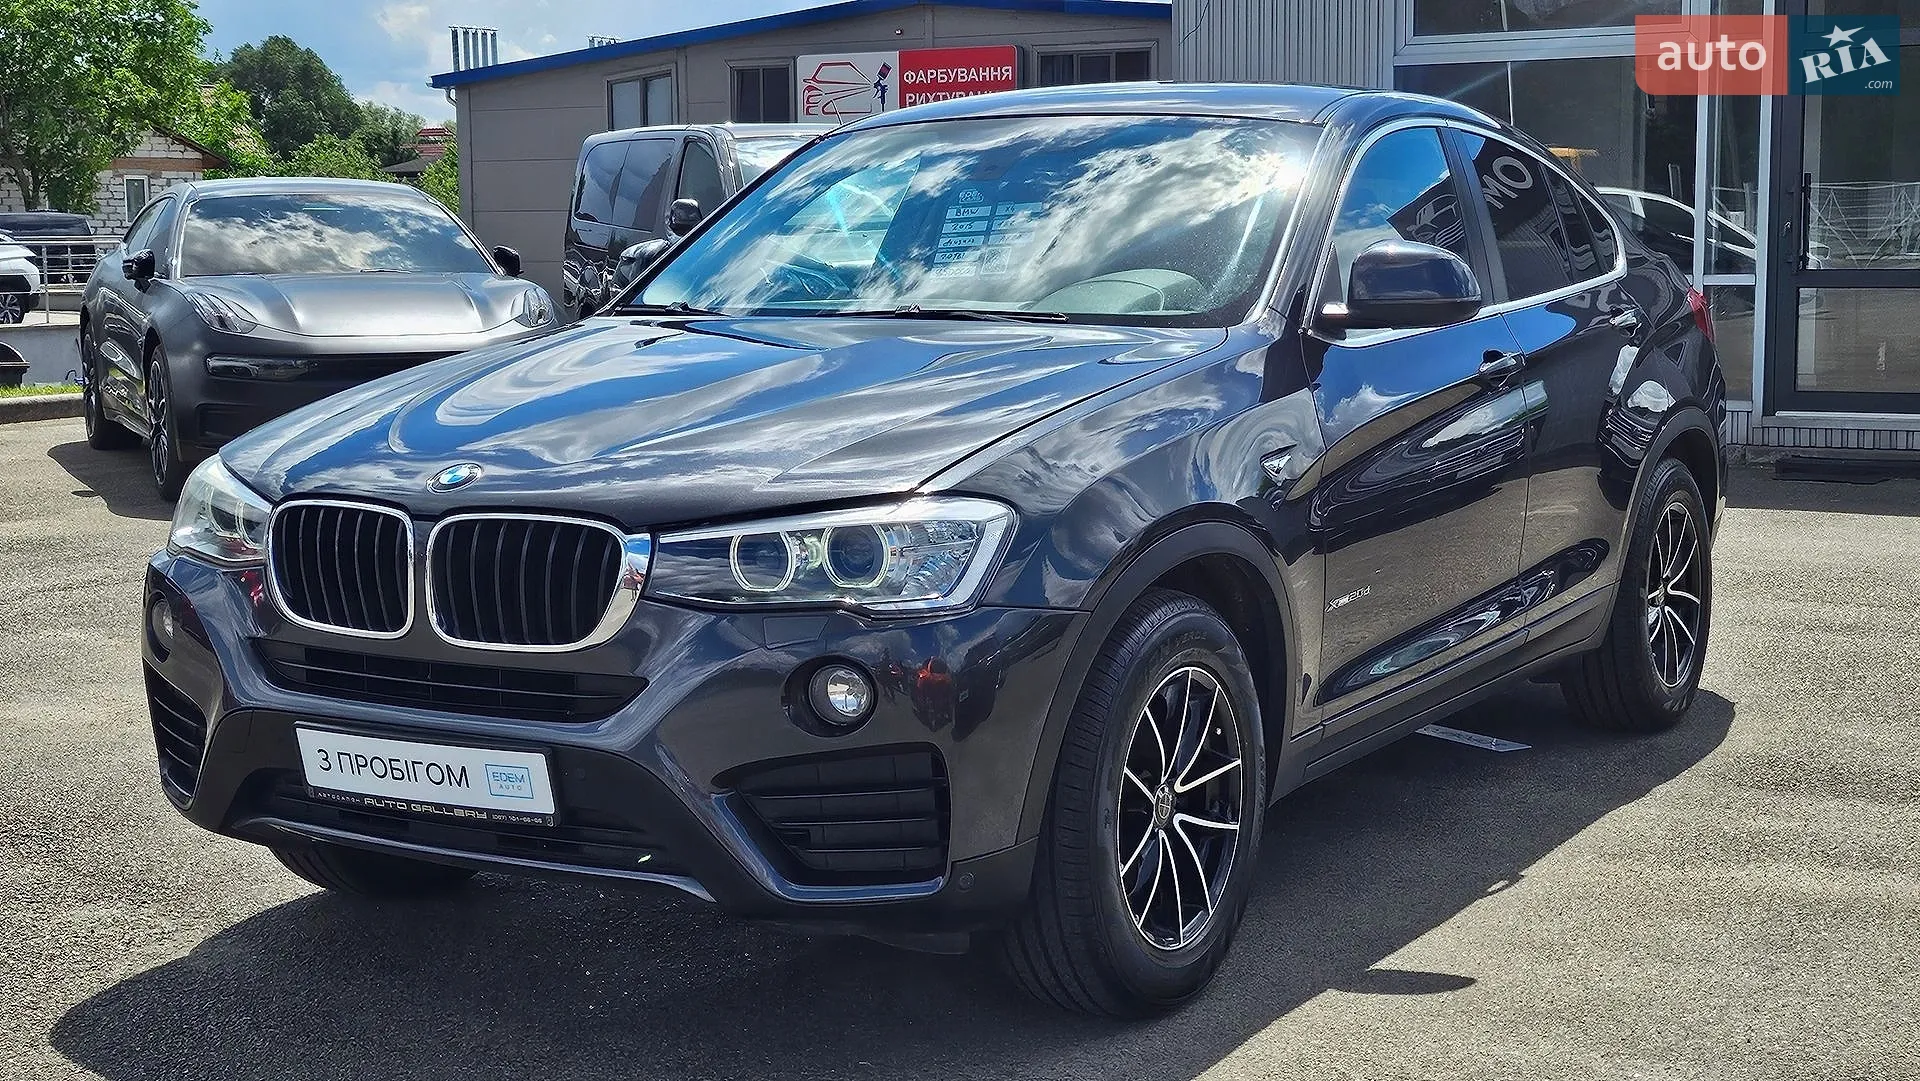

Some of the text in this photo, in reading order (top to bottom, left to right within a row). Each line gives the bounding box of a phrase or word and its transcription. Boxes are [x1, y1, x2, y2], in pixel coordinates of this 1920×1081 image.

[903, 66, 1013, 84] ФАРБУВАННЯ
[955, 206, 980, 216] BMW
[336, 751, 472, 790] ПРОБІГОМ
[491, 771, 526, 784] EDEM
[364, 797, 408, 810] AUTO
[410, 803, 488, 819] GALLERY
